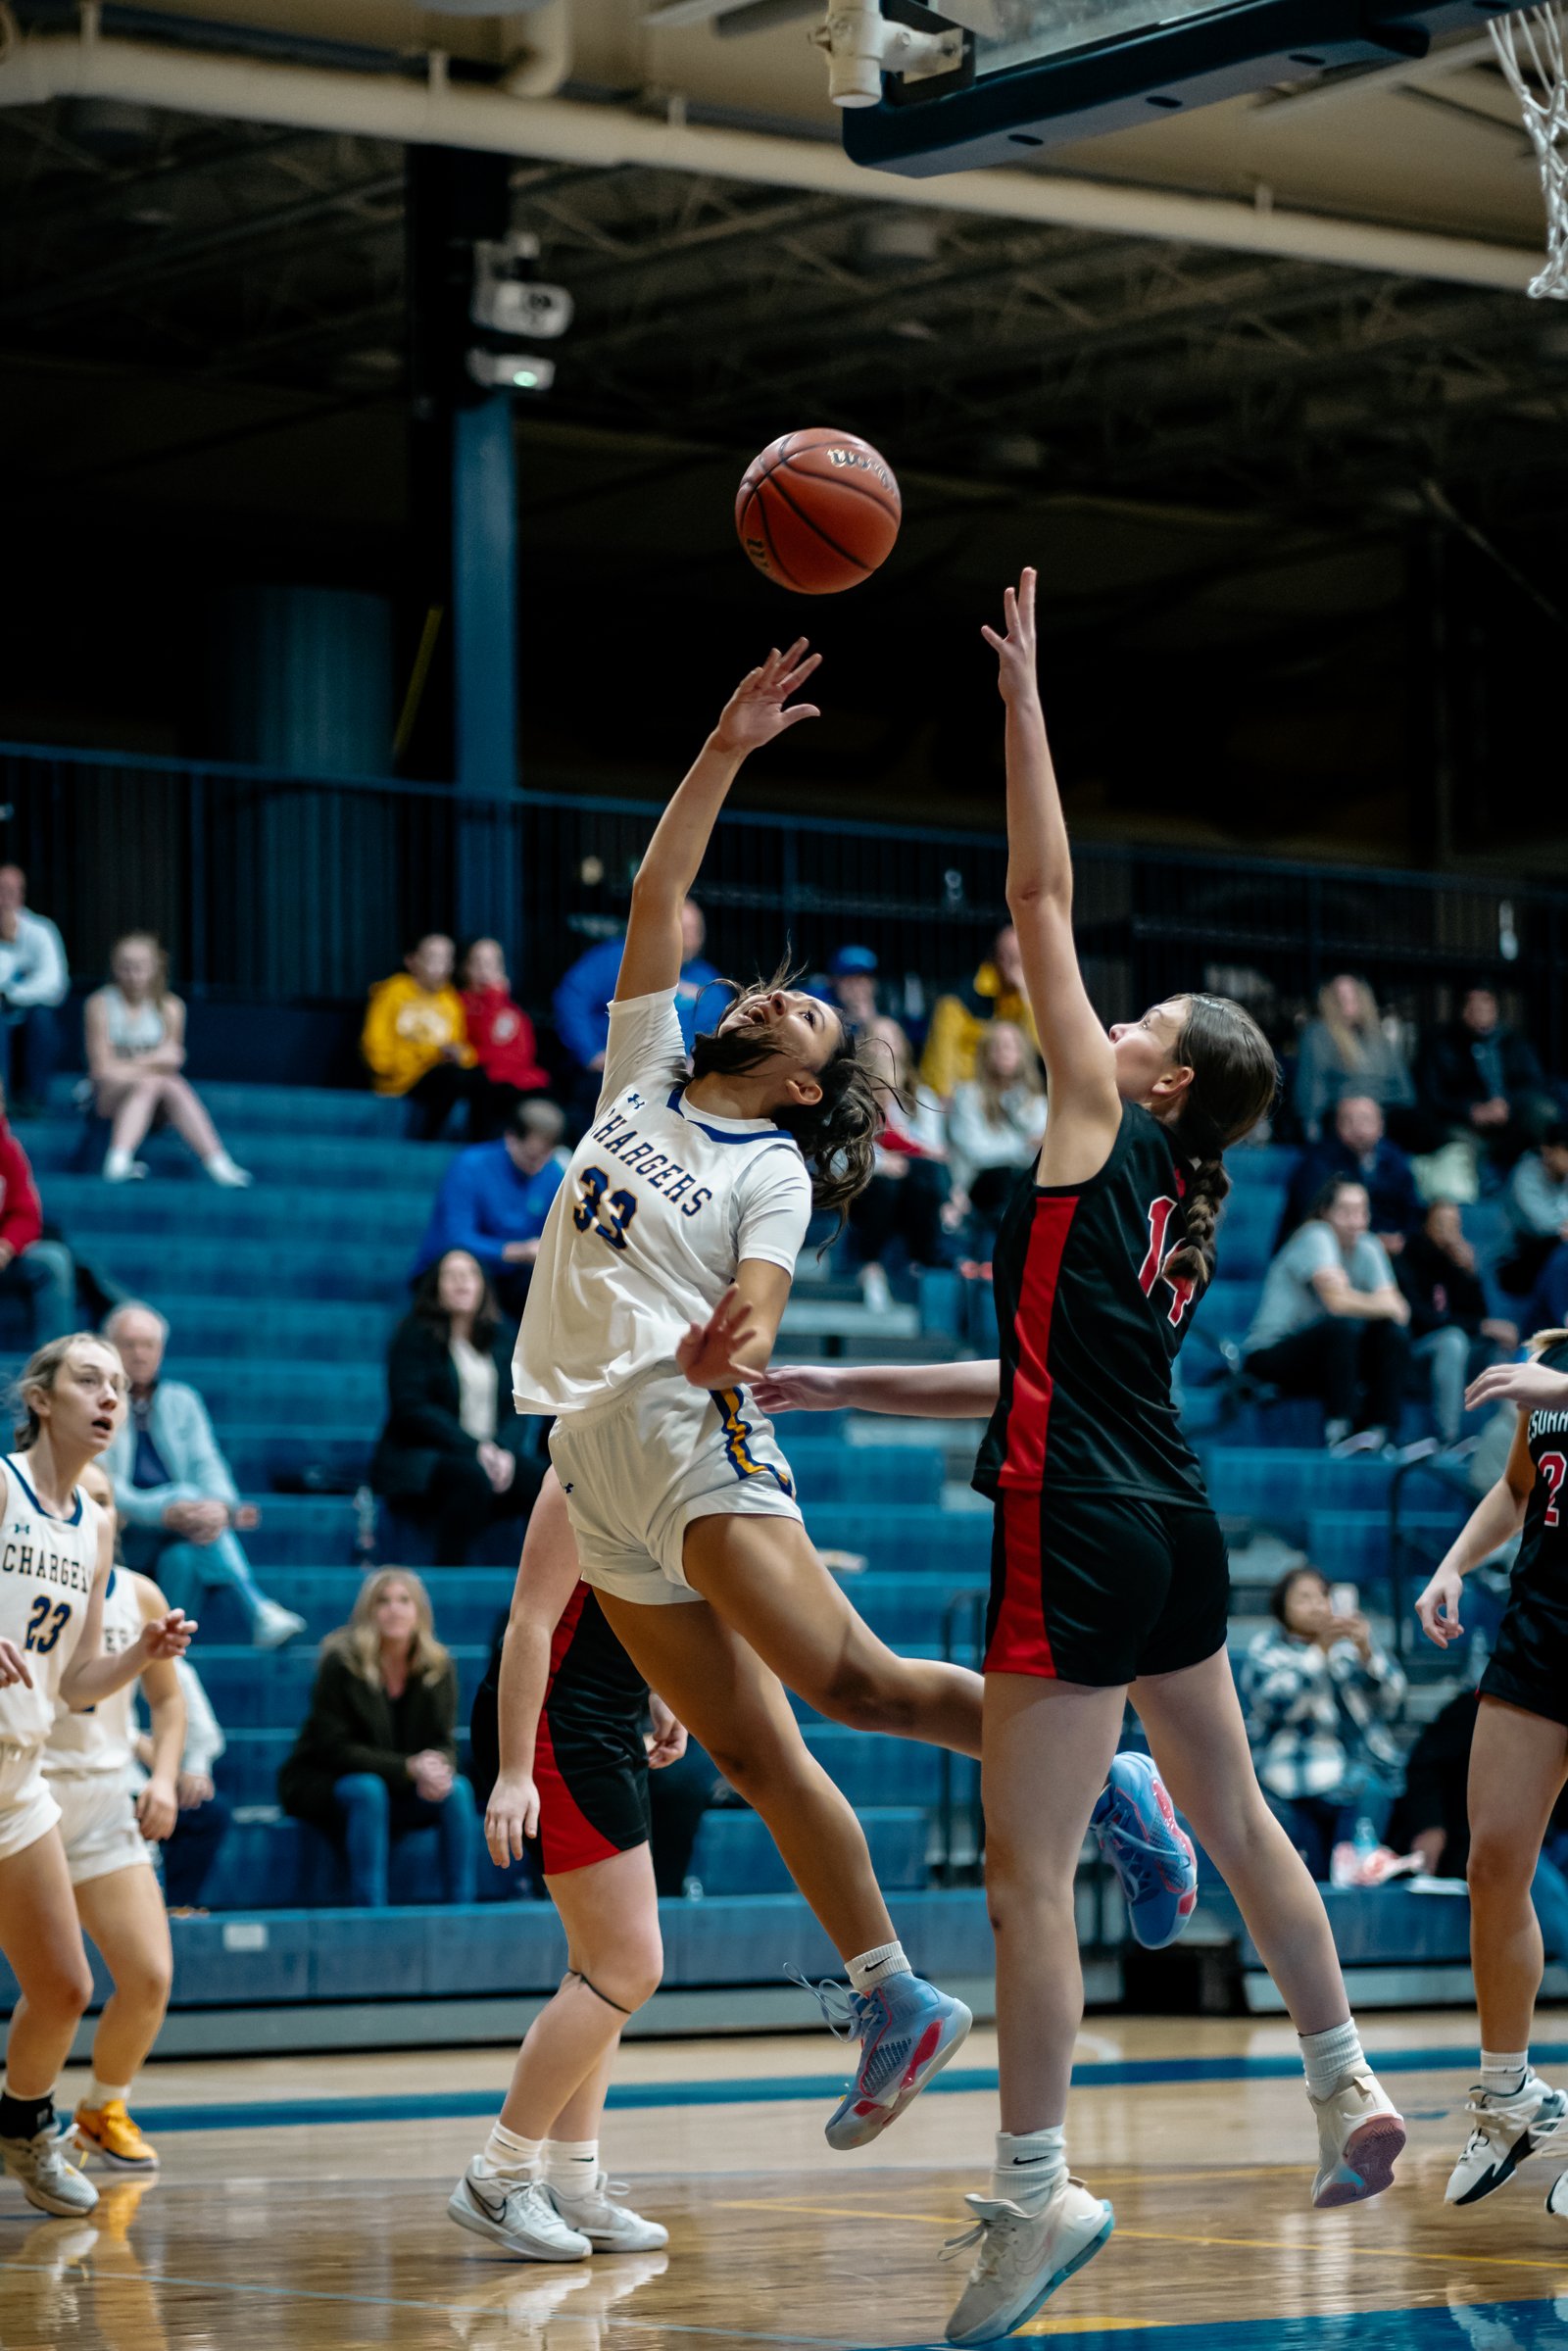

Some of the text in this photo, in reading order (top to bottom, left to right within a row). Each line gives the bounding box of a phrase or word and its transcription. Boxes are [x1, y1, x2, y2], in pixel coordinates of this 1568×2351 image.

[591, 1108, 713, 1217] HARGERS
[573, 1165, 637, 1249] 33
[1538, 1451, 1567, 1527] 2
[24, 1594, 72, 1654] 23
